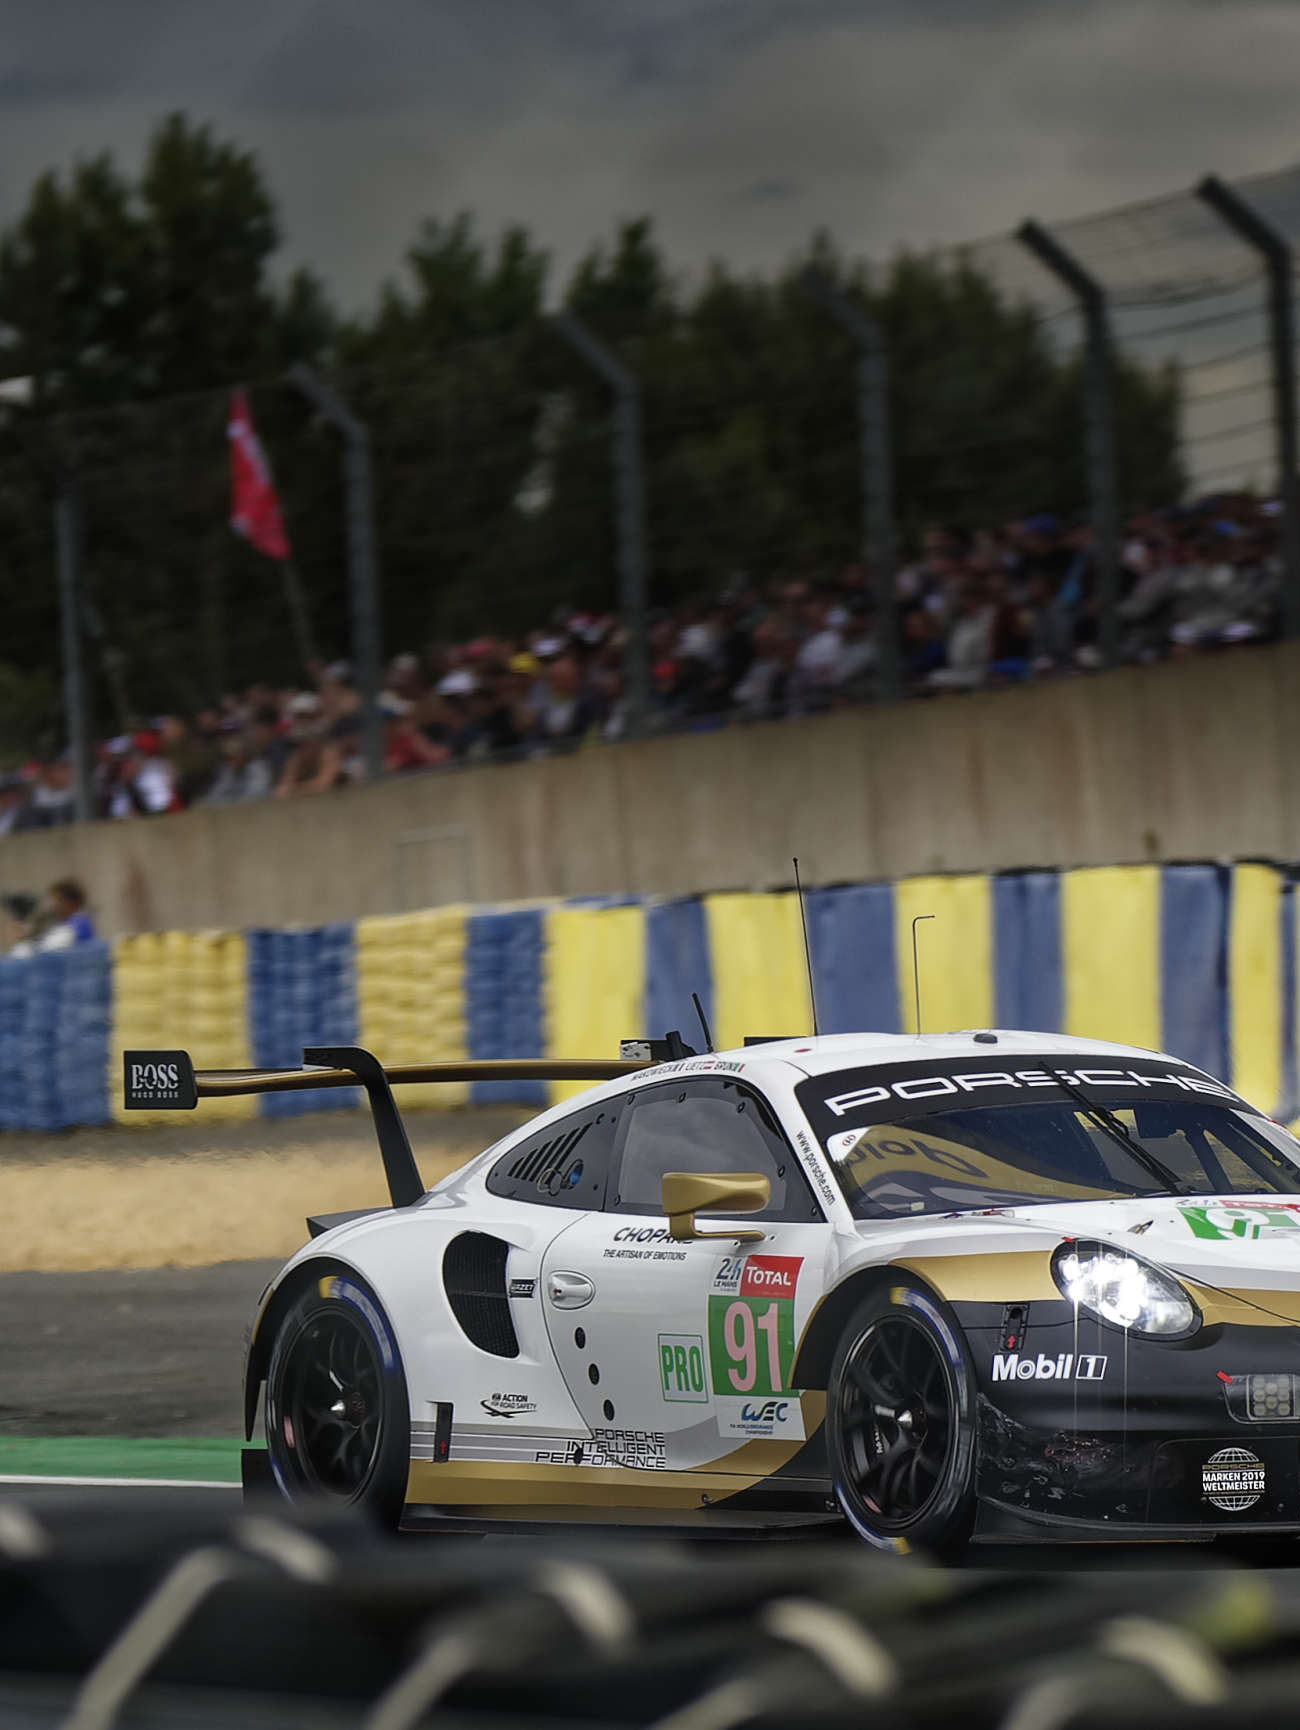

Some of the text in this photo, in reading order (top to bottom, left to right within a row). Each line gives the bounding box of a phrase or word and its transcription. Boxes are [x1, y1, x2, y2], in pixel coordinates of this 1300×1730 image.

[131, 1064, 178, 1089] BOSS
[824, 1069, 1239, 1117] PORSCHE
[796, 1129, 836, 1206] www.porsche.com
[614, 1227, 694, 1244] CHOPA
[724, 1301, 783, 1392] 91
[661, 1345, 703, 1393] PRO
[992, 1354, 1073, 1381] Mobil
[502, 1394, 528, 1402] ACTION
[741, 1401, 788, 1422] WEC
[595, 1428, 664, 1443] PORSCHE
[567, 1441, 666, 1455] INTELLIGENT
[1203, 1471, 1265, 1482] MARKEN 2019
[1203, 1481, 1265, 1491] WELTMEISTER
